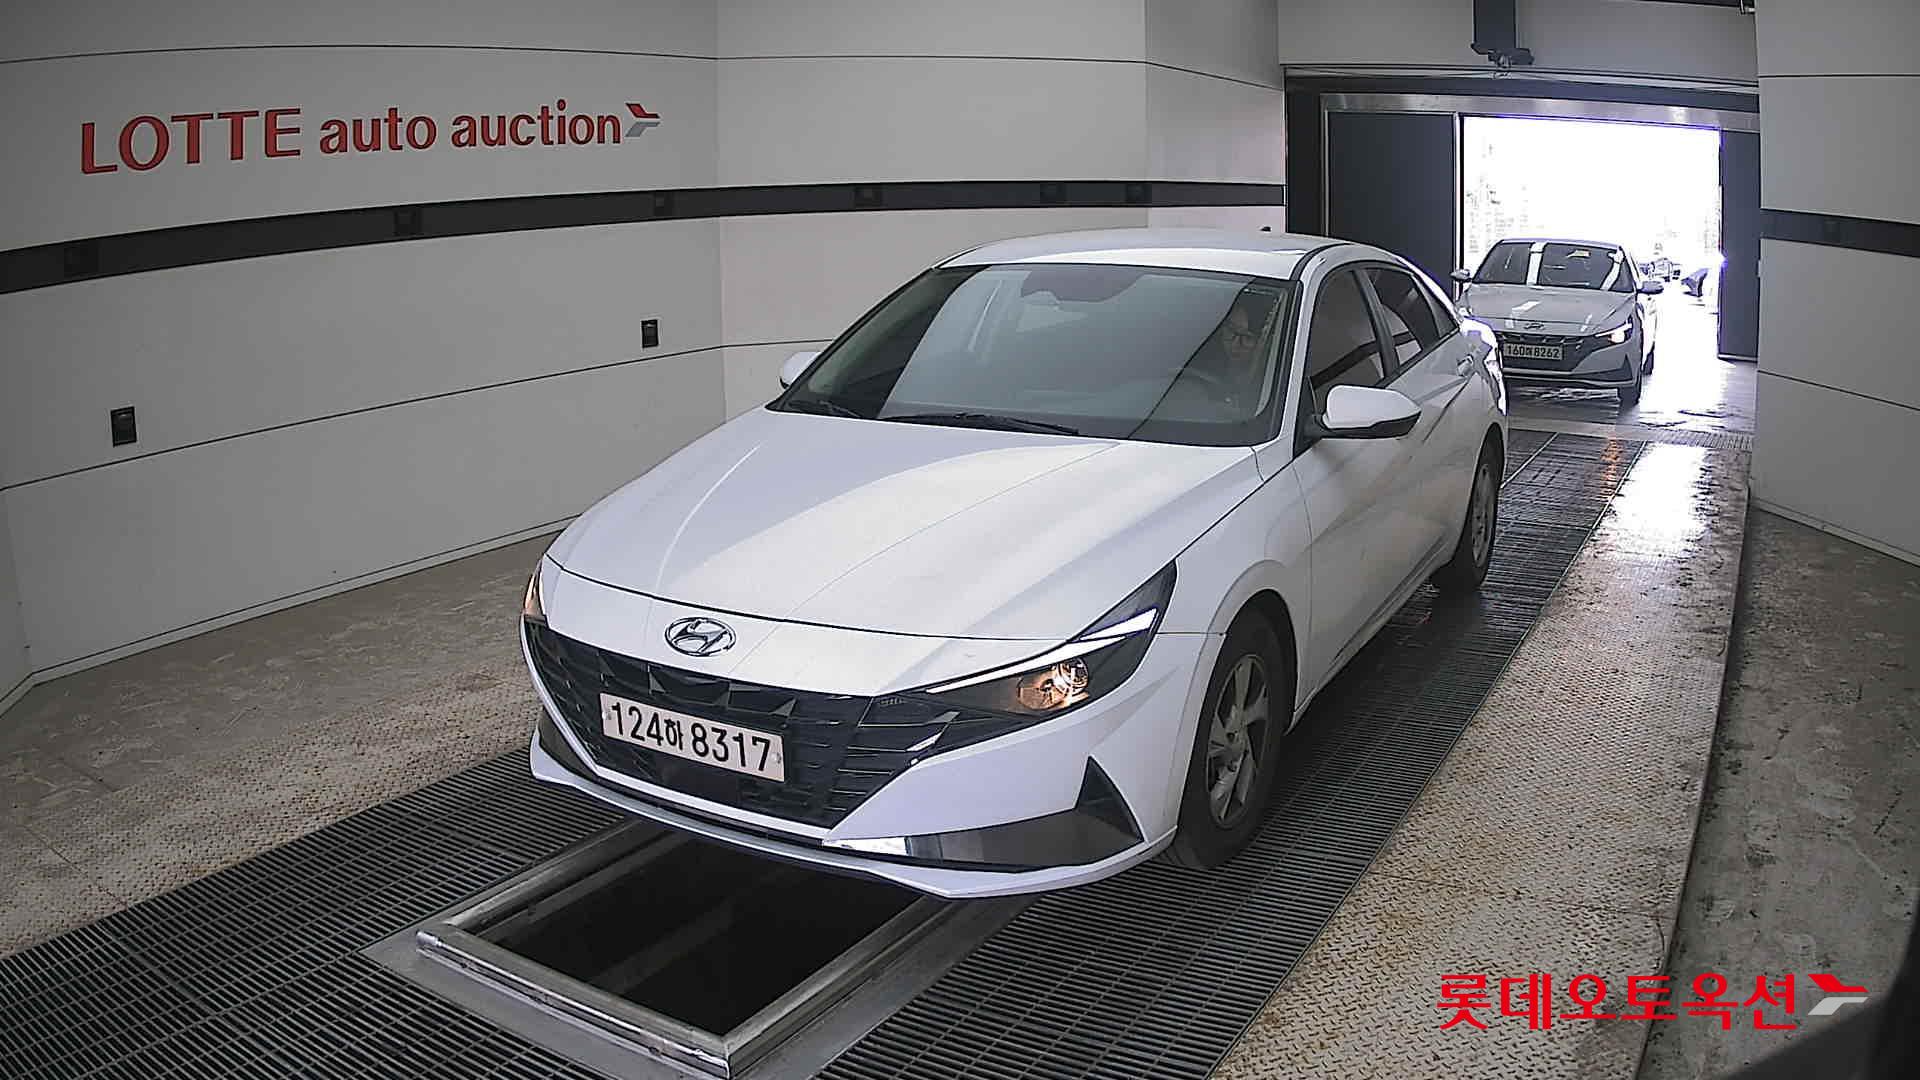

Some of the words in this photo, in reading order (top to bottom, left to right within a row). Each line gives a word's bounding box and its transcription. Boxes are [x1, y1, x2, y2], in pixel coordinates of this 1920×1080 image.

[81, 107, 301, 174] LOTTE
[319, 107, 437, 154] auto
[451, 99, 622, 147] auction
